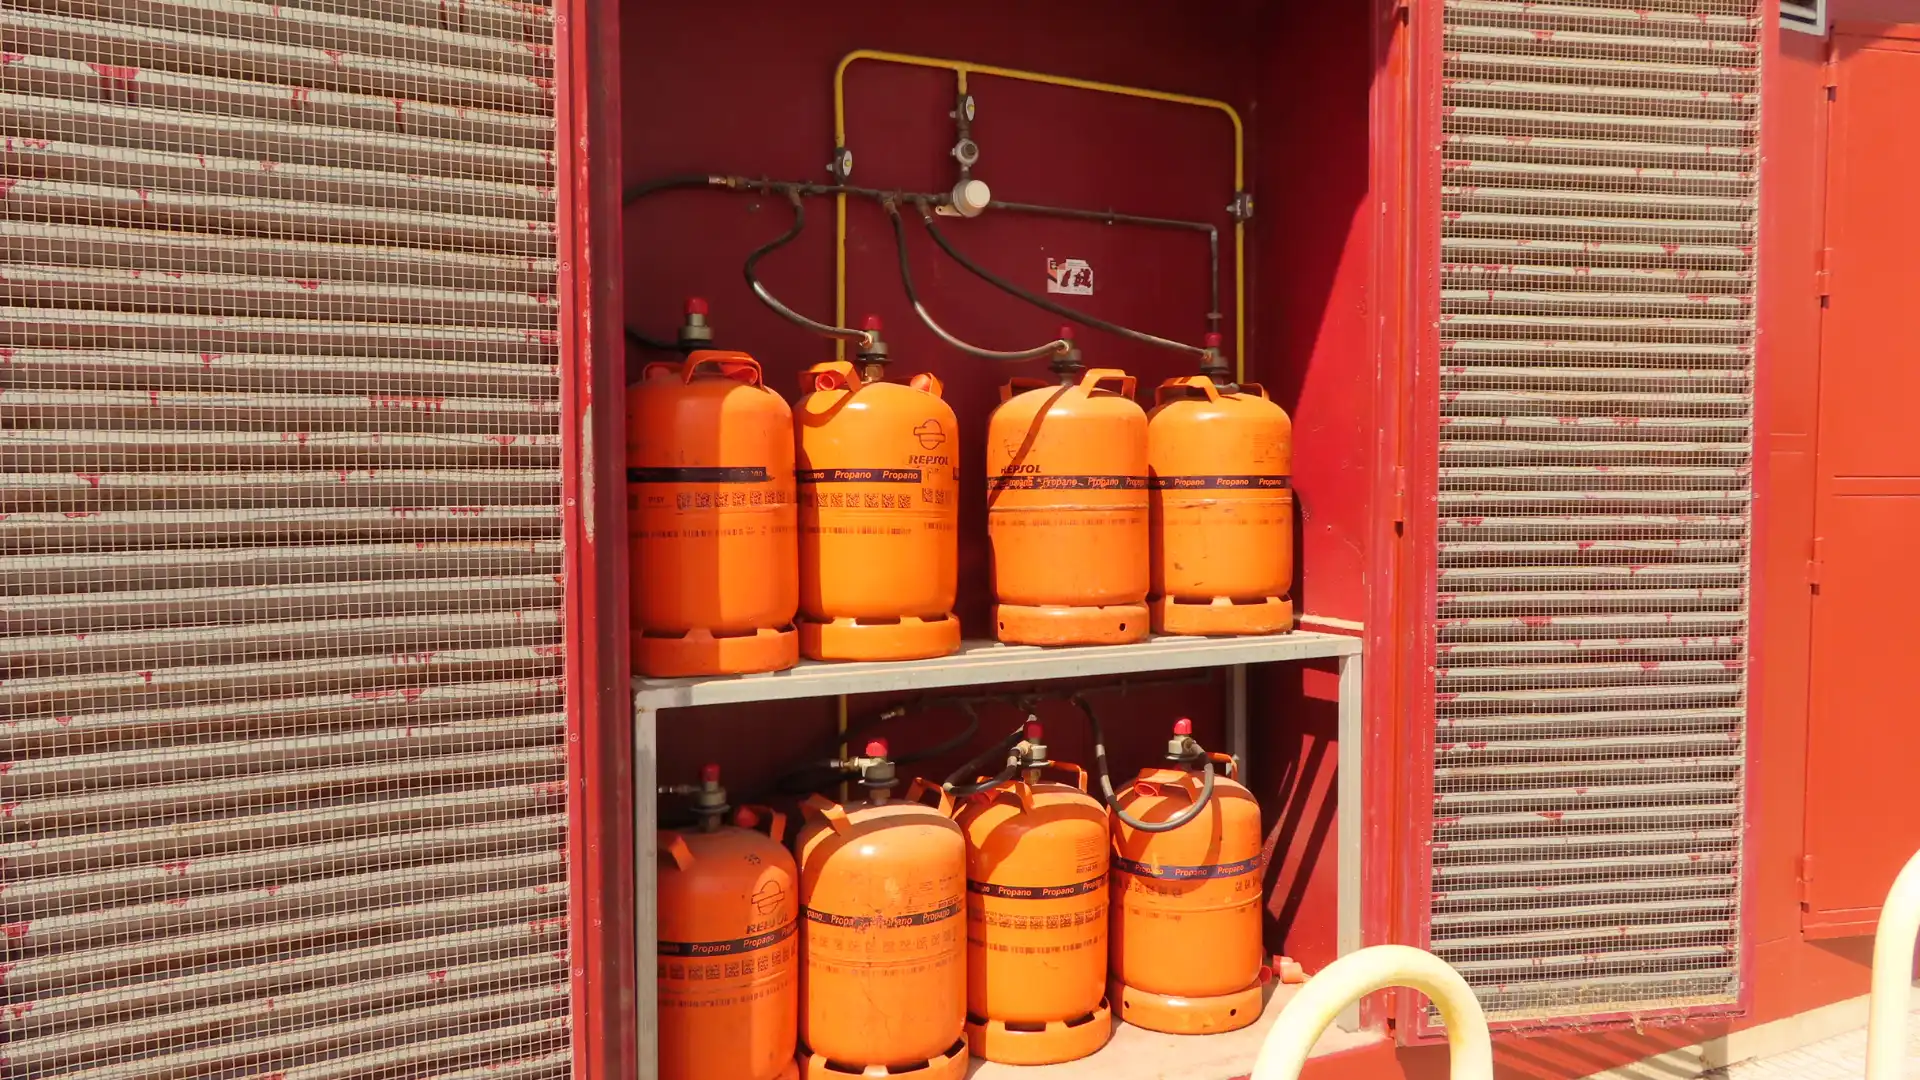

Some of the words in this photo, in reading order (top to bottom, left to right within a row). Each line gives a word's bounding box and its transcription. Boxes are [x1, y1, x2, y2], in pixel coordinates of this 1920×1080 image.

[908, 454, 948, 466] REPSOL
[834, 470, 872, 480] Propano
[883, 470, 918, 480] Propano
[1174, 478, 1205, 487] Propano
[1216, 477, 1249, 487] Propano
[1175, 868, 1207, 877] Propano
[1217, 864, 1244, 874] Propano
[998, 886, 1032, 897] Propano
[1042, 887, 1074, 896] Propano
[922, 908, 950, 923] Propano
[691, 944, 731, 954] Propano
[743, 935, 775, 948] Propano
